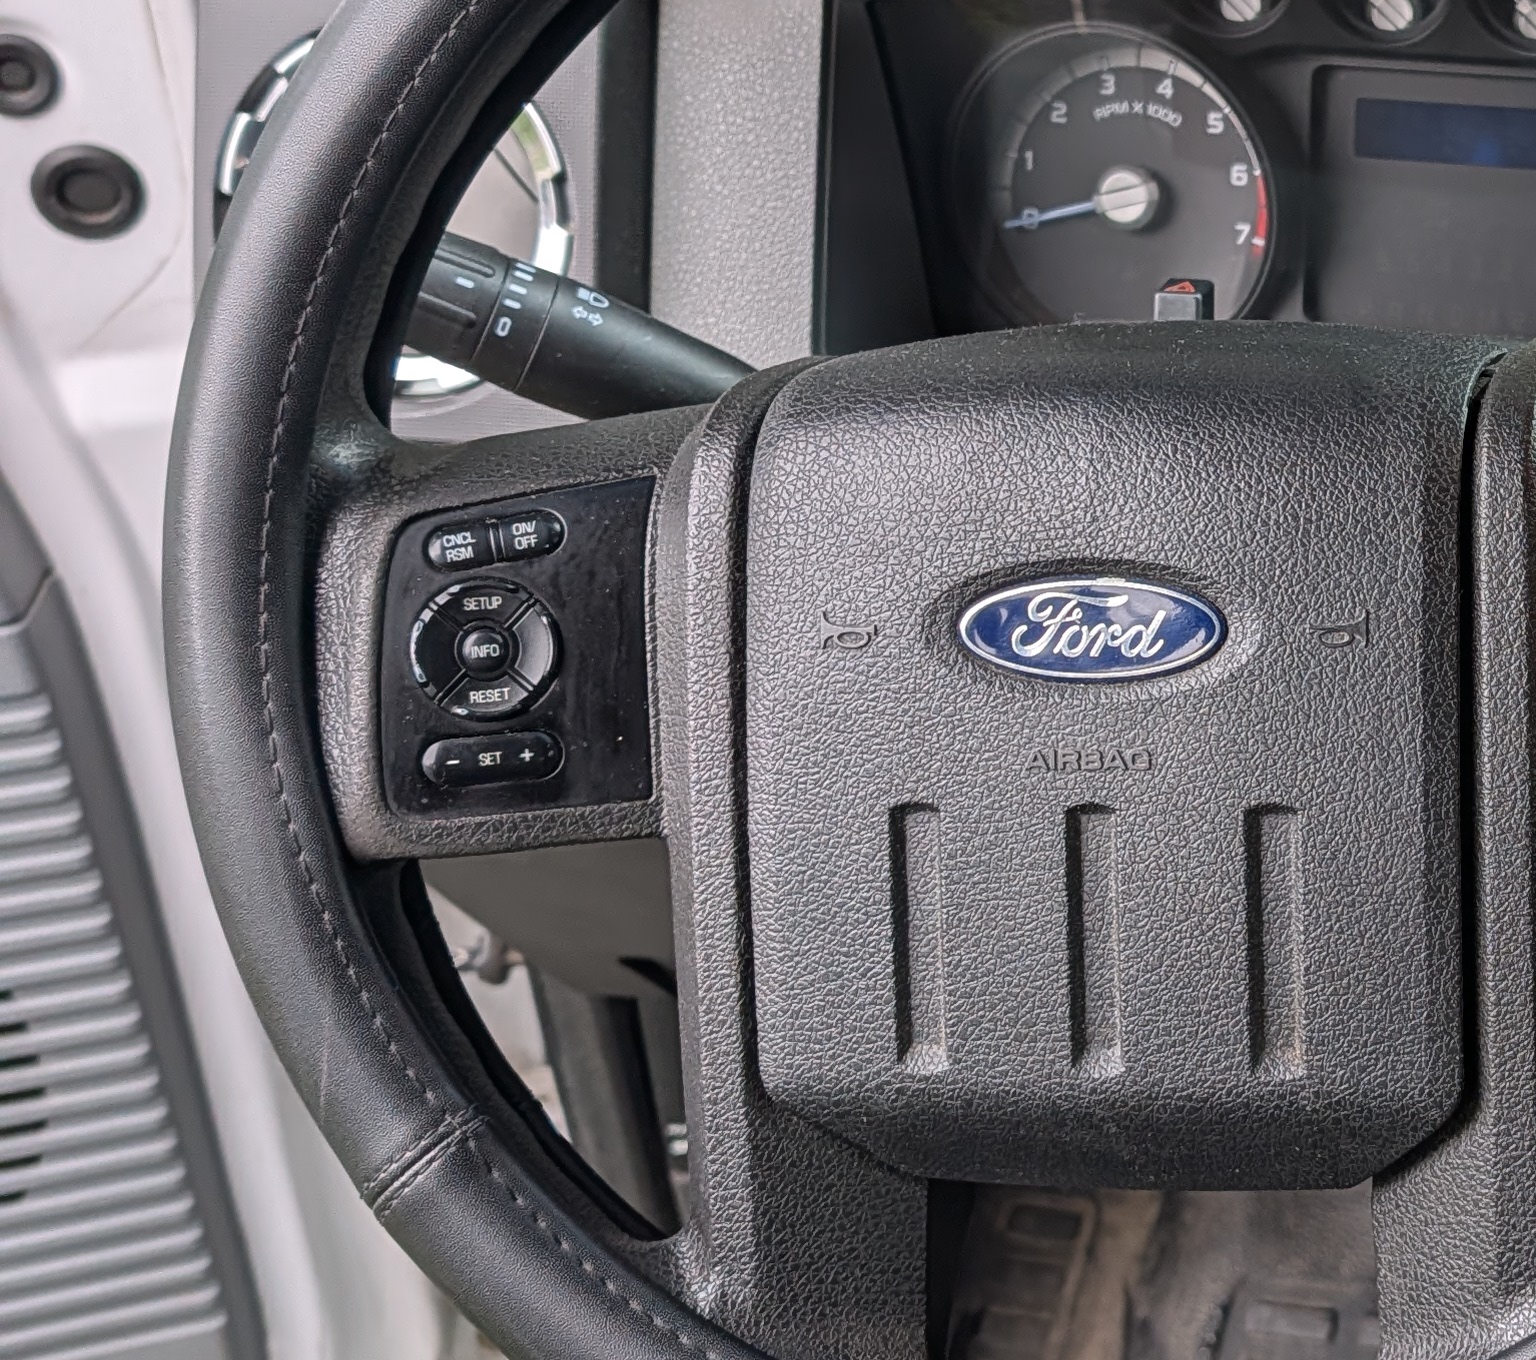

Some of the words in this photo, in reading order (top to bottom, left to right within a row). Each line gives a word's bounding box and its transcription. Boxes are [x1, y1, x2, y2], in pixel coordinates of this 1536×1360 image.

[1100, 73, 1116, 96] 3
[1156, 77, 1174, 99] 4
[1050, 101, 1068, 124] 2
[1092, 99, 1129, 122] RPM
[1146, 100, 1183, 128] 1000
[1205, 111, 1225, 135] 5
[1023, 149, 1035, 172] 1
[1229, 163, 1249, 187] 6
[1233, 222, 1252, 245] 7
[512, 520, 537, 536] ON/
[442, 531, 476, 548] CNCL
[514, 534, 538, 550] OFF
[445, 545, 474, 562] RSM
[463, 595, 503, 612] SETUP
[1011, 591, 1167, 658] Ford
[470, 643, 500, 659] INFO
[469, 687, 511, 704] RESET
[478, 751, 503, 767] SET
[1025, 748, 1153, 772] AIRBAG
